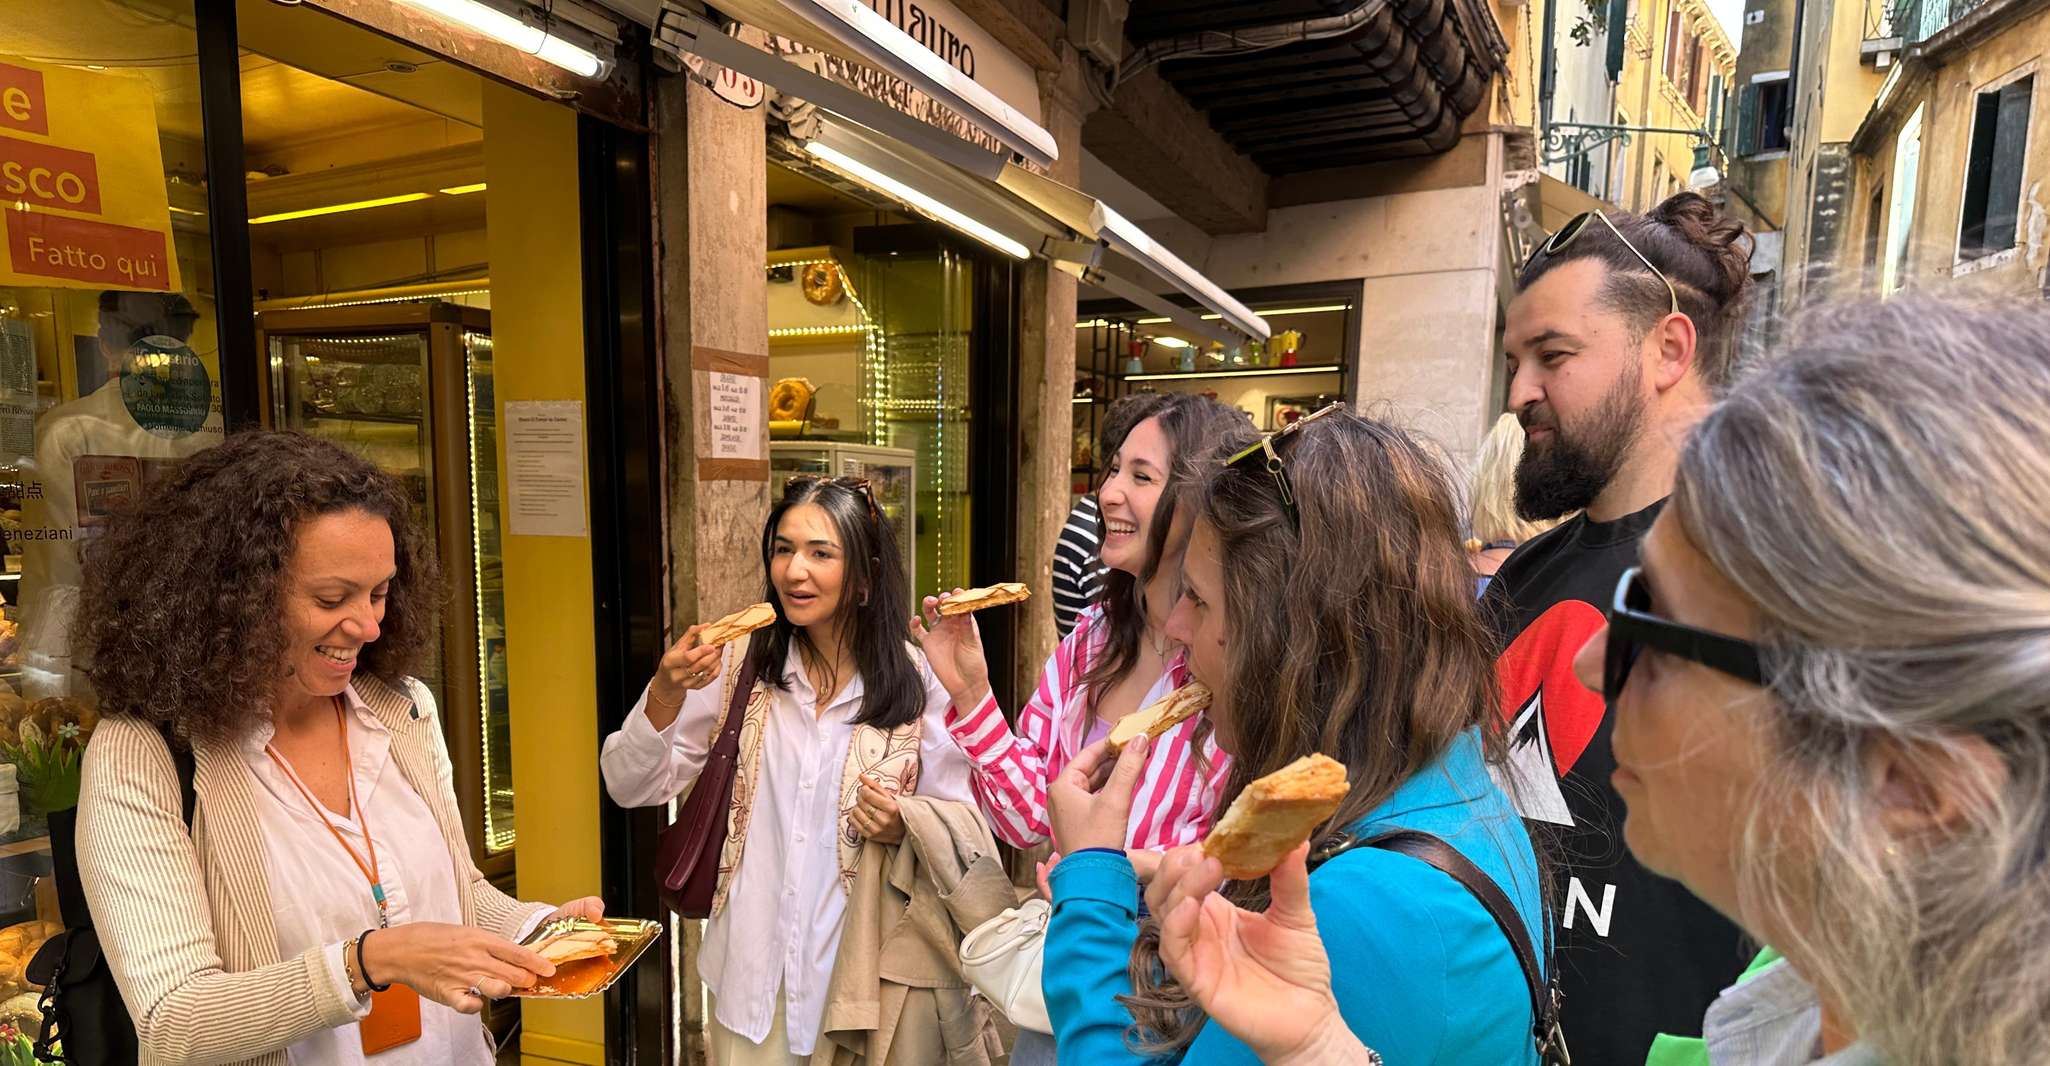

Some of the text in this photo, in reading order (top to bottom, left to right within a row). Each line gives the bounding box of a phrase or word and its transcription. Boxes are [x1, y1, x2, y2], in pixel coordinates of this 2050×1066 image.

[3, 87, 32, 121] e
[28, 237, 157, 281] Fatto qui
[1562, 876, 1616, 938] N
